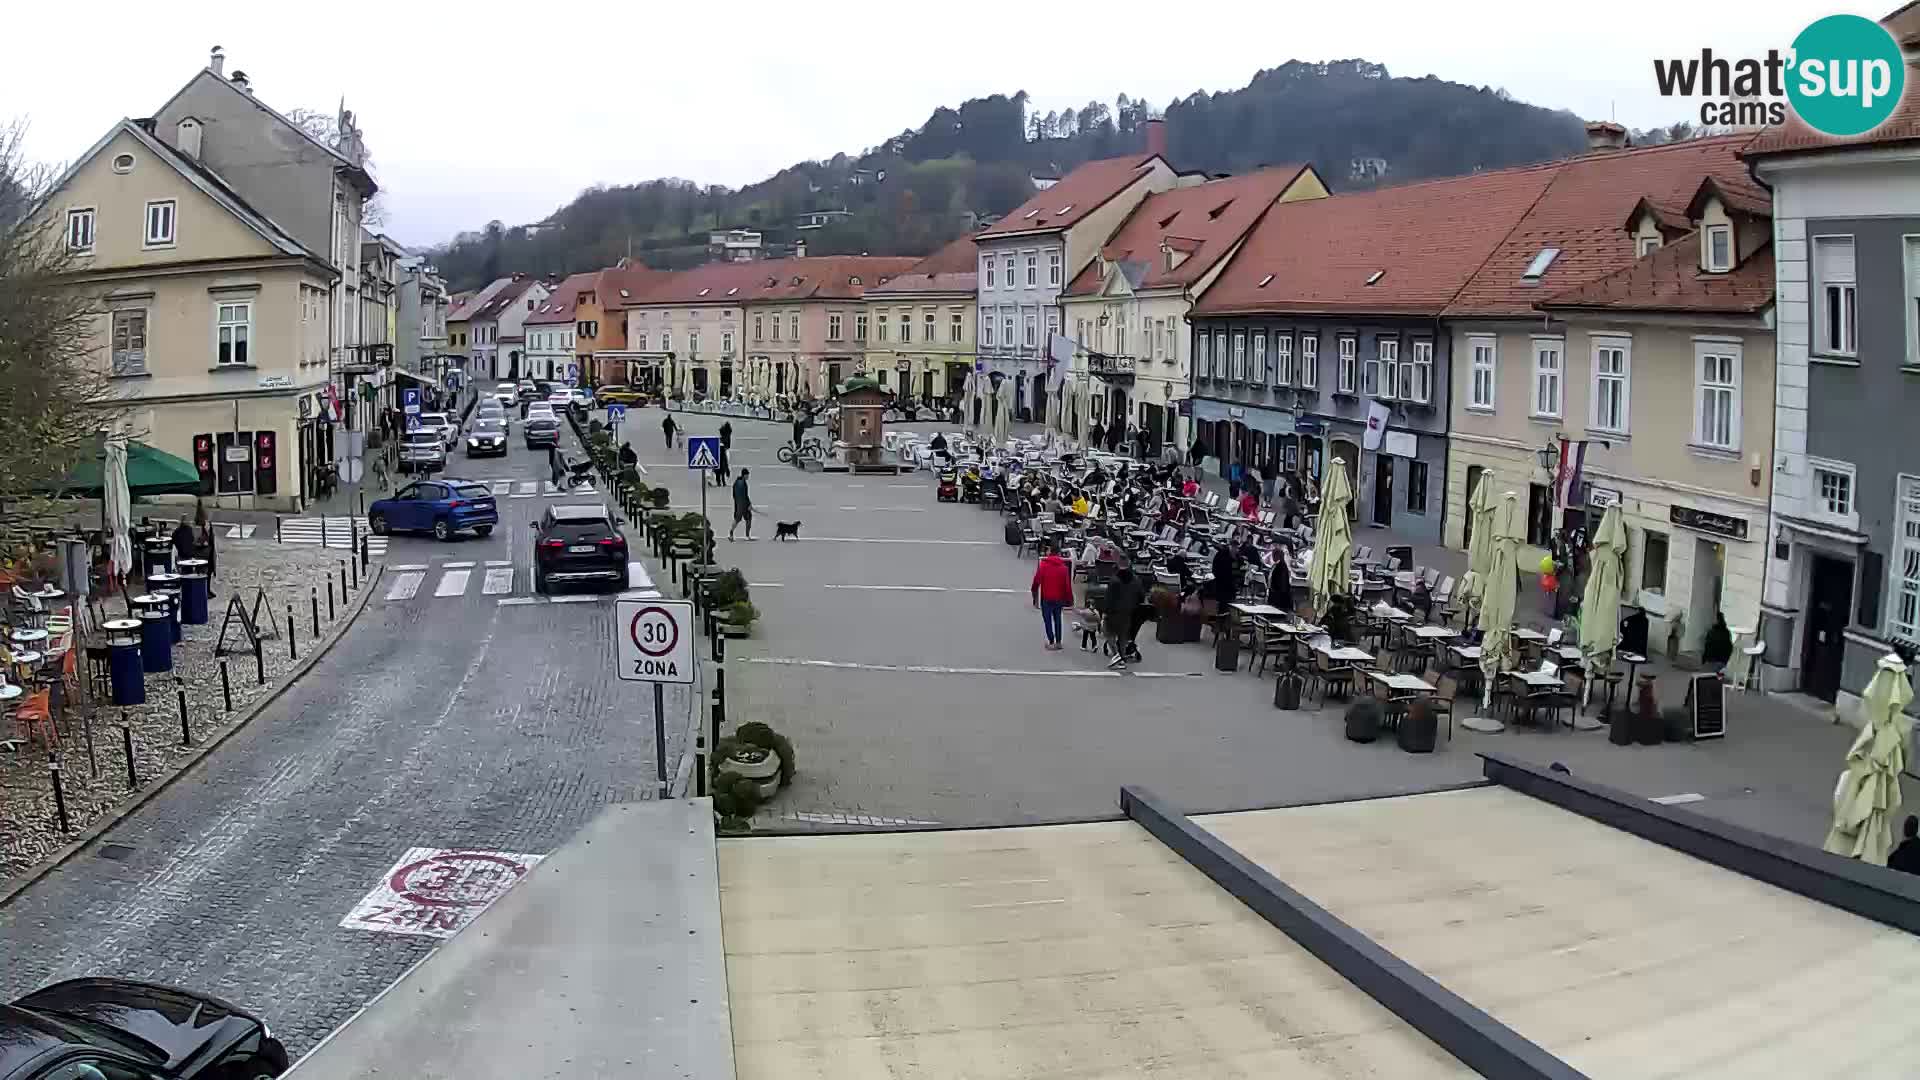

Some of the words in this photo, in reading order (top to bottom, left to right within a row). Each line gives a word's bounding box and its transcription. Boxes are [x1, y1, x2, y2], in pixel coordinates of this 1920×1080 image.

[408, 392, 415, 402] P
[643, 623, 667, 643] 30
[633, 660, 678, 676] ZONA
